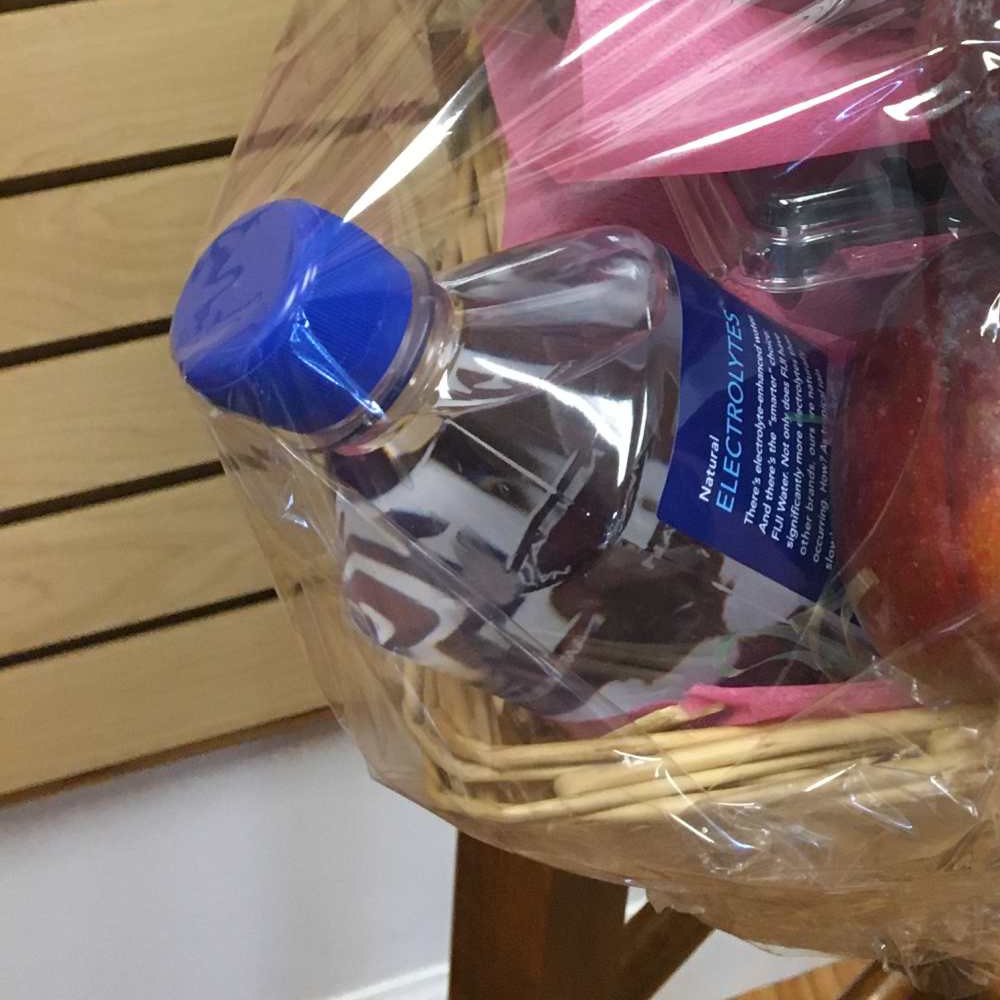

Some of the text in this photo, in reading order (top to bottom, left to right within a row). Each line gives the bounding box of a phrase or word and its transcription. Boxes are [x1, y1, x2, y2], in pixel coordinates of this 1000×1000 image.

[780, 357, 789, 379] FIJI
[715, 309, 744, 513] ELECTROLYTES
[752, 343, 767, 474] electrolyte-enhanced
[781, 381, 791, 411] does
[792, 356, 804, 428] eectrolytes
[768, 432, 778, 454] the
[781, 412, 791, 440] only
[699, 434, 720, 502] Natural
[781, 441, 791, 468] Not
[744, 477, 761, 525] There's
[765, 457, 777, 501] there's
[800, 516, 812, 555] other
[808, 427, 816, 456] ours
[758, 503, 772, 535] And
[771, 515, 785, 541] FIJI
[786, 467, 804, 549] significantly
